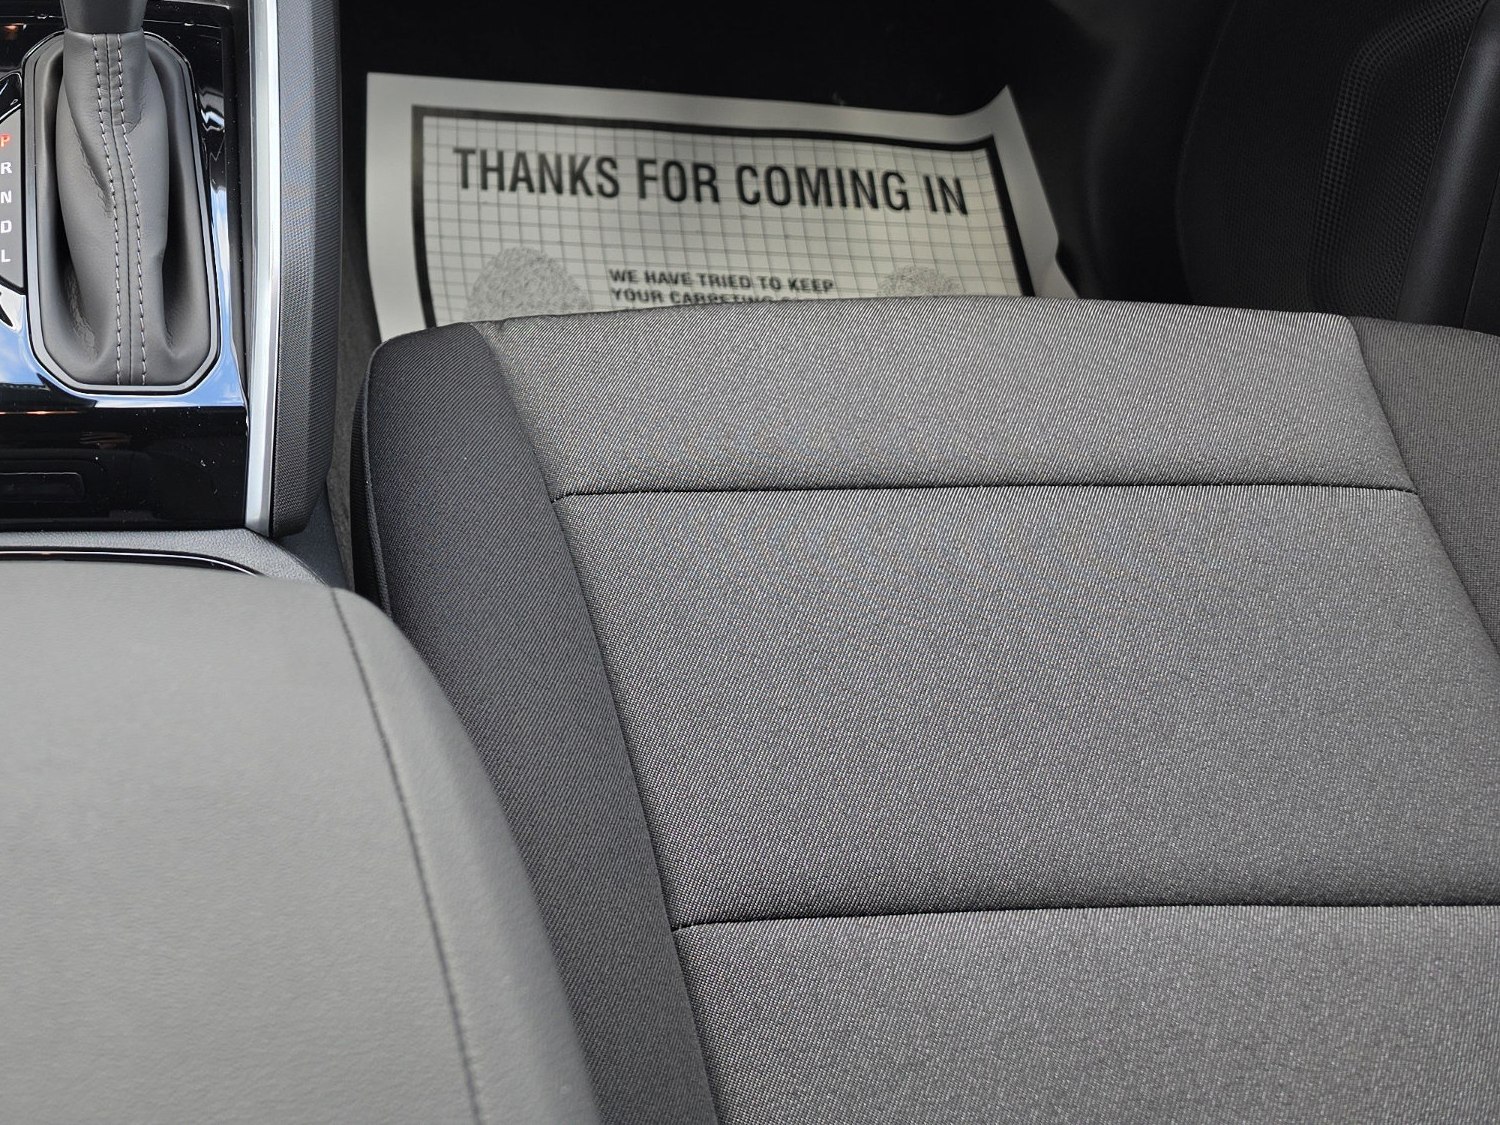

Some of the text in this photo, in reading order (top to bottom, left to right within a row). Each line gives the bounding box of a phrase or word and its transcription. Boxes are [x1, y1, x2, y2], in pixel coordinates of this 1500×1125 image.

[0, 135, 12, 263] P R N D L
[453, 146, 969, 217] THANKS FOR COMING IN
[608, 268, 834, 293] WE HAVE TRIED TO KEEP
[610, 287, 664, 304] YOUR
